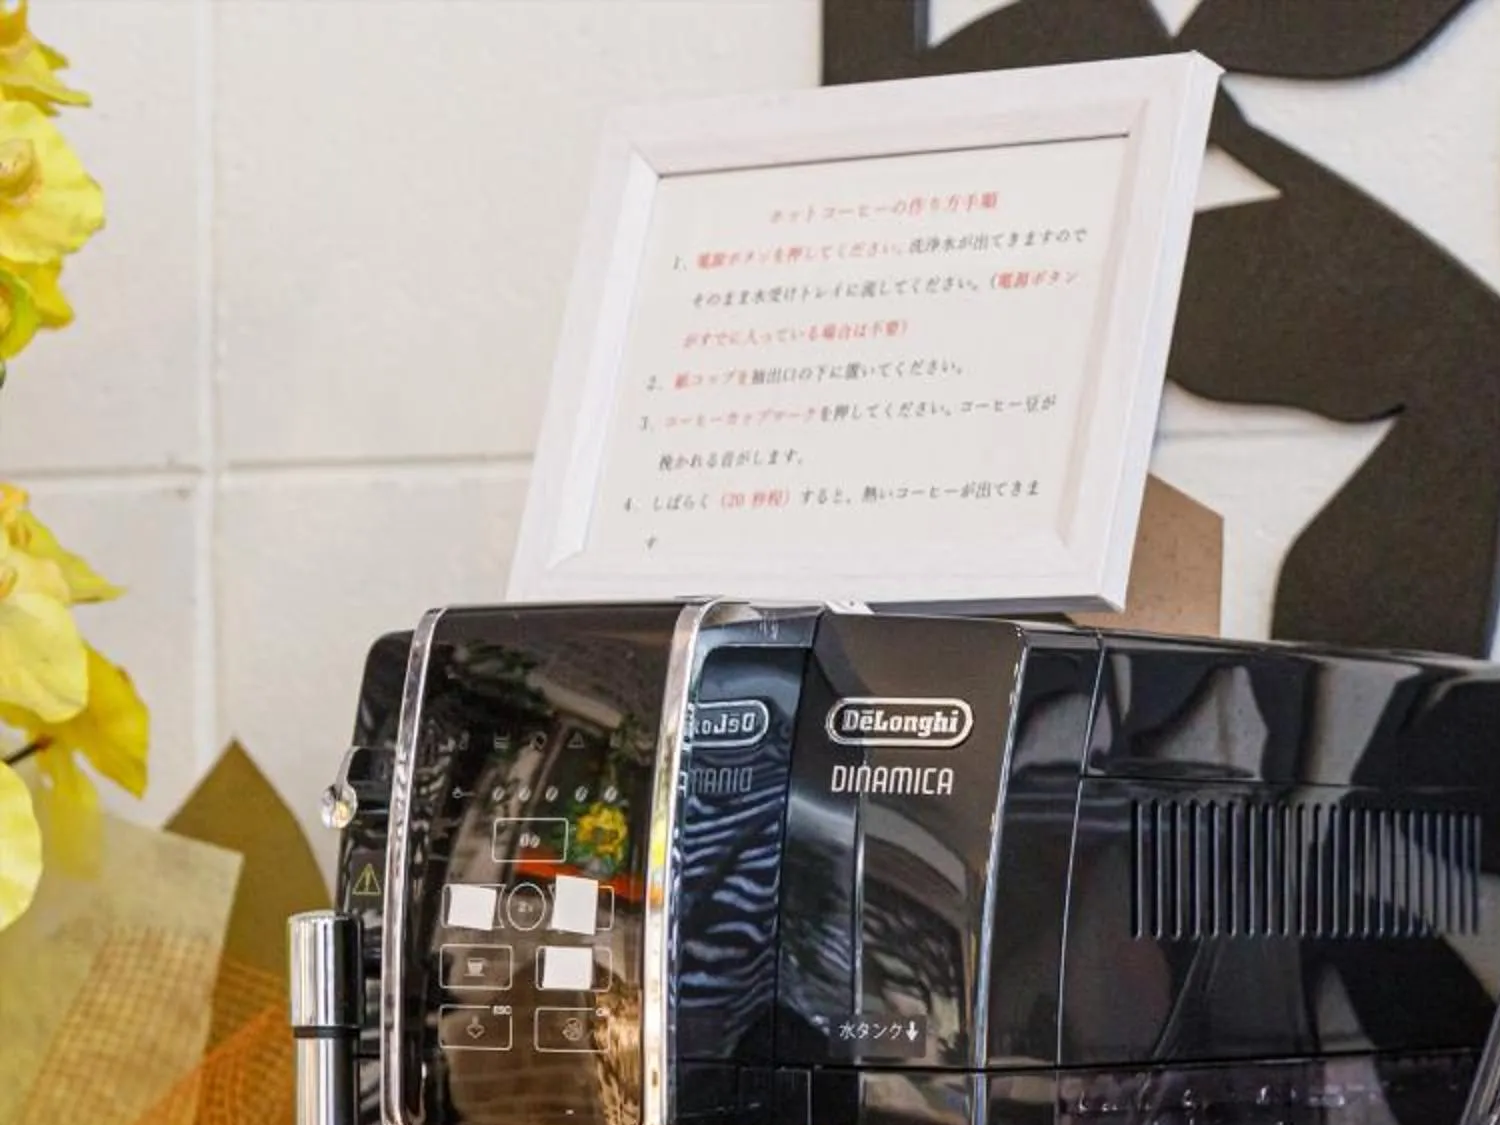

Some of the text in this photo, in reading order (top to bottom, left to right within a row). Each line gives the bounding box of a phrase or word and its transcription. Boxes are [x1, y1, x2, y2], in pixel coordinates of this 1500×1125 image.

[831, 765, 955, 795] DINAMICA
[839, 1020, 903, 1041] 水タンク
